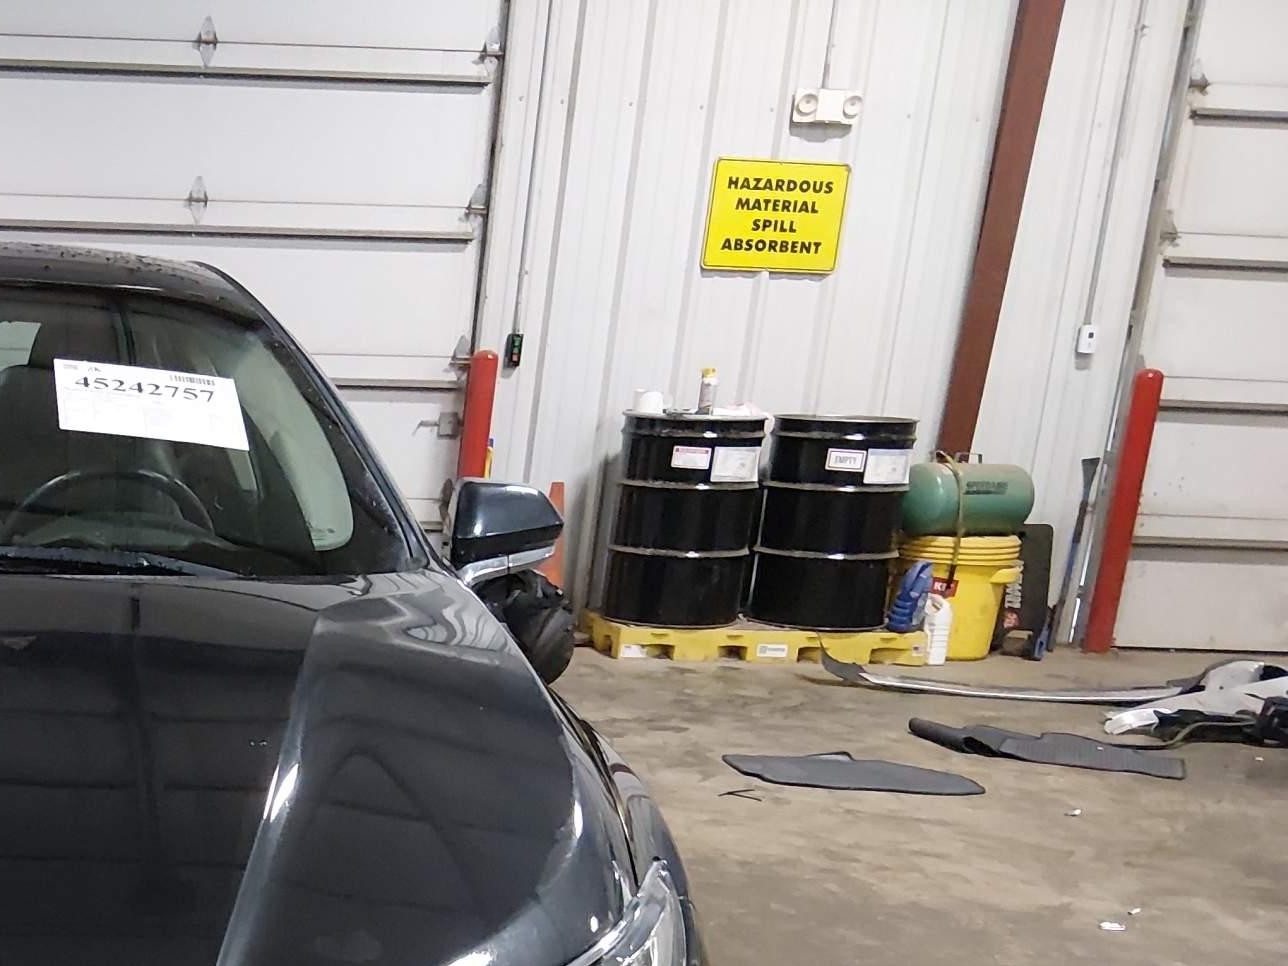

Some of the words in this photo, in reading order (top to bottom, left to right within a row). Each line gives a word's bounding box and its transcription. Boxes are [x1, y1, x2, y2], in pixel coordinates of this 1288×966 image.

[727, 176, 834, 194] HAZARDOUS
[735, 197, 819, 214] MATERIAL
[751, 218, 797, 233] SPILL
[720, 238, 822, 254] ABSORBENT
[74, 376, 215, 402] 45242757
